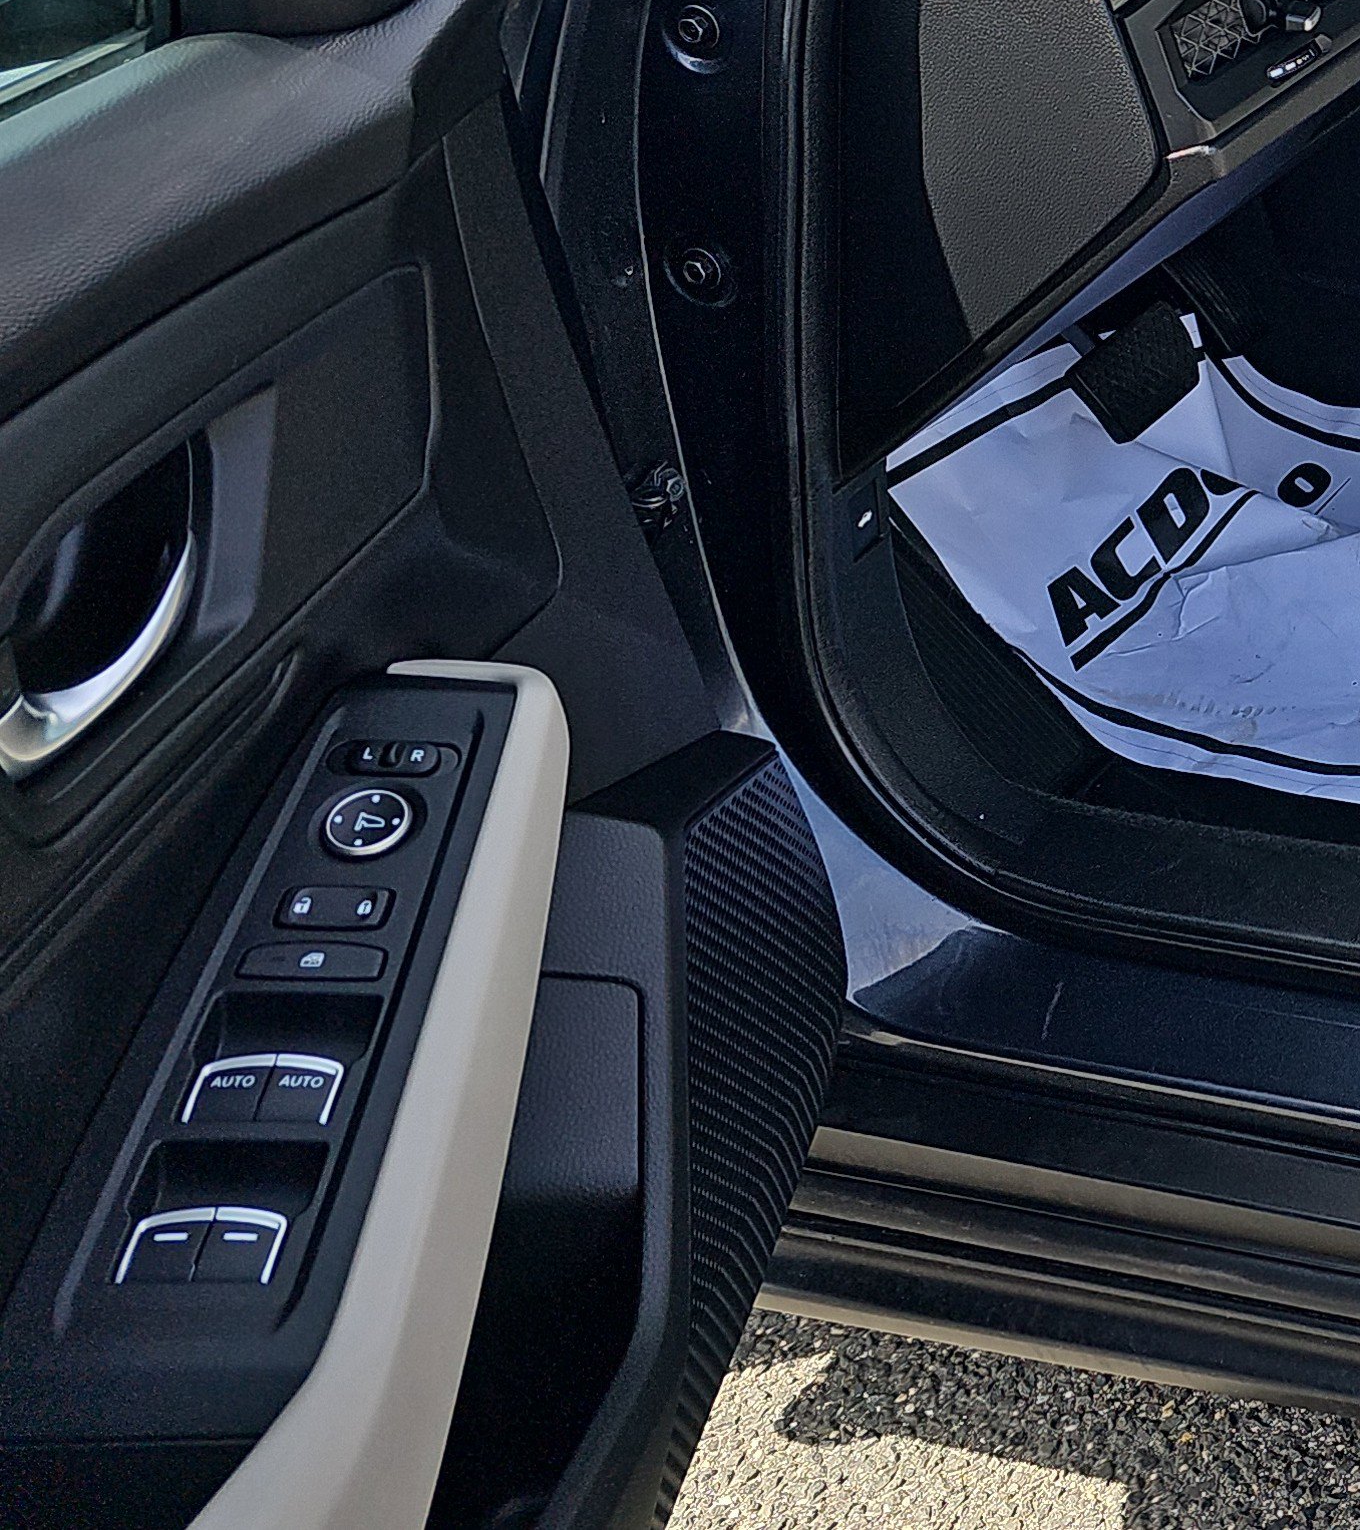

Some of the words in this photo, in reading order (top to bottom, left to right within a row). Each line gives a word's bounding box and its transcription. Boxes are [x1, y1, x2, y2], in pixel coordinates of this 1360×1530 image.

[362, 746, 374, 761] L
[410, 749, 425, 762] R
[210, 1074, 256, 1089] AUTO
[278, 1074, 324, 1089] AUTO
